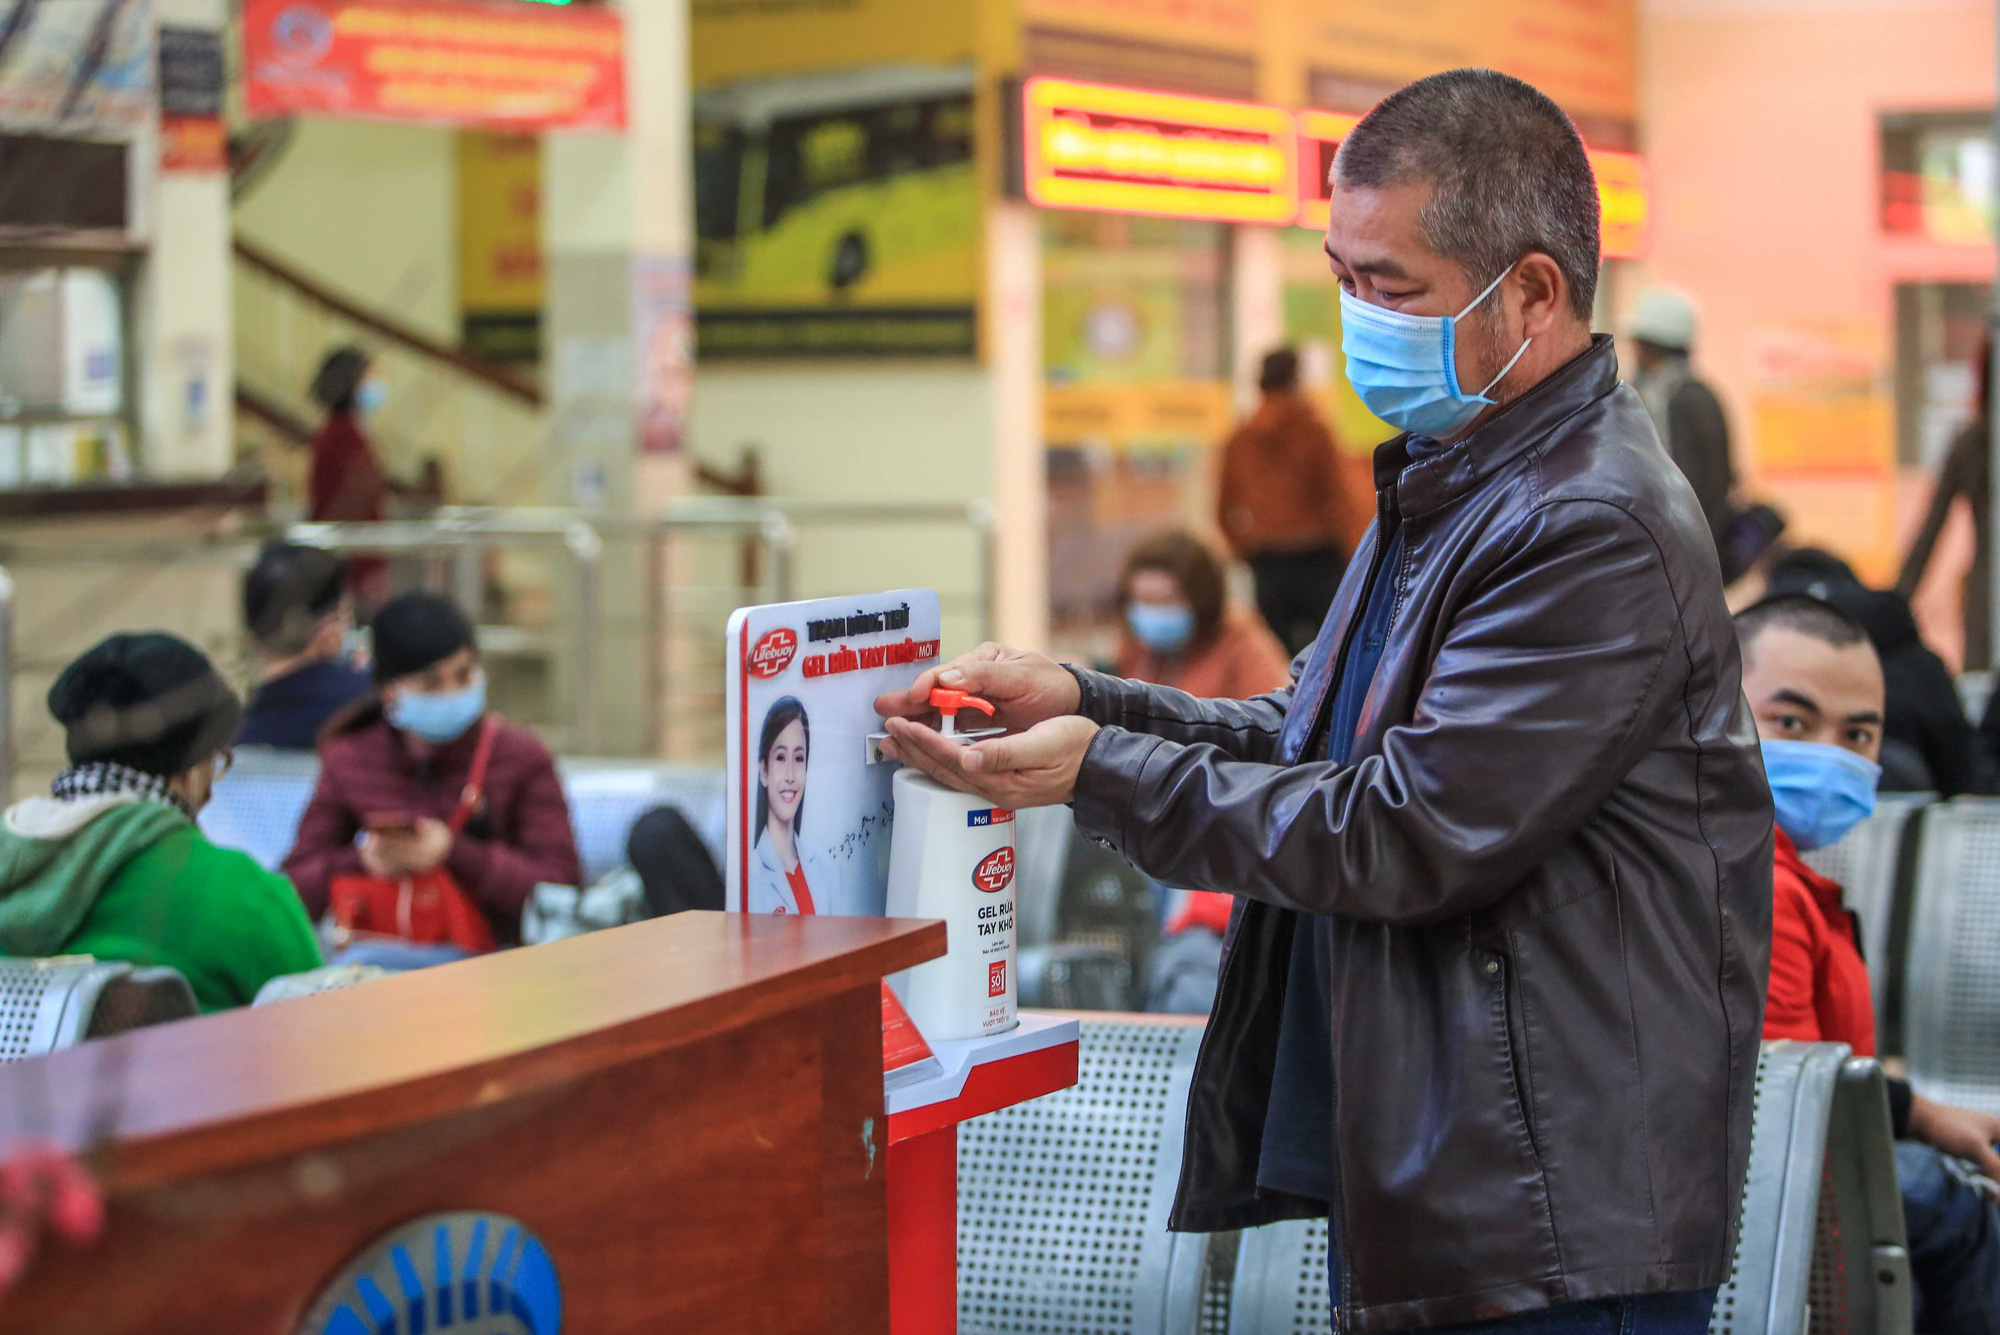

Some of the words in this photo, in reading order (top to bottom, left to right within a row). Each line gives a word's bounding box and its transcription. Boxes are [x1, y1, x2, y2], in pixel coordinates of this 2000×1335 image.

[753, 644, 795, 663] Lifebuoy
[802, 654, 829, 678] GEL
[858, 645, 886, 670] TAY
[918, 643, 933, 658] MỚI
[974, 814, 988, 825] Mới
[979, 862, 1013, 877] Lifebuoy
[978, 905, 997, 919] GEL
[978, 922, 996, 936] TAY
[998, 915, 1013, 932] KHÔ
